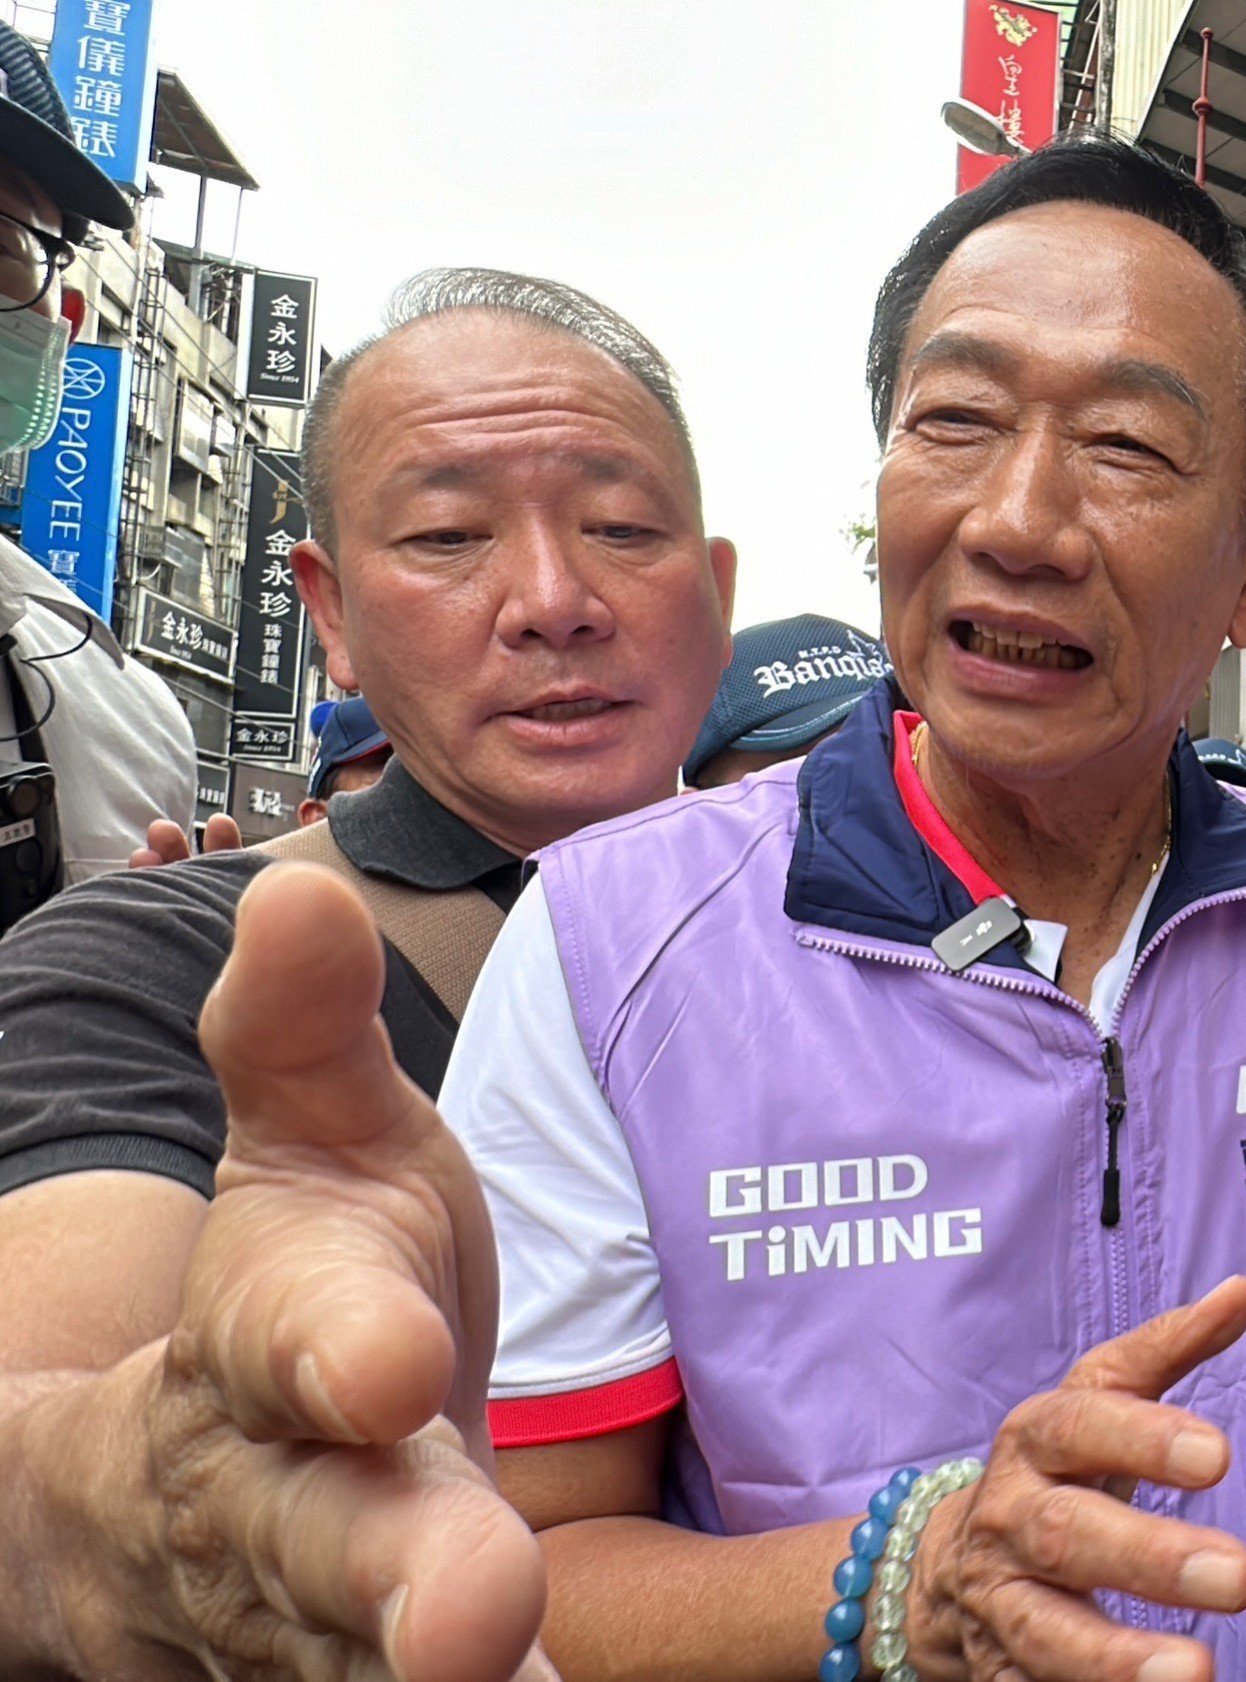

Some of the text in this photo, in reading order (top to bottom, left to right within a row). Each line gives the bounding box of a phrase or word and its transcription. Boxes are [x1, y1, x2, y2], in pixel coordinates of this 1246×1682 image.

[71, 0, 131, 158] 寶儀鐘錶
[266, 293, 299, 373] 金永珍
[50, 407, 91, 541] PAOYEE
[259, 529, 297, 618] 金永珍
[161, 611, 203, 650] 金永珍
[236, 728, 289, 744] 金永珍
[709, 1154, 928, 1218] GOOD
